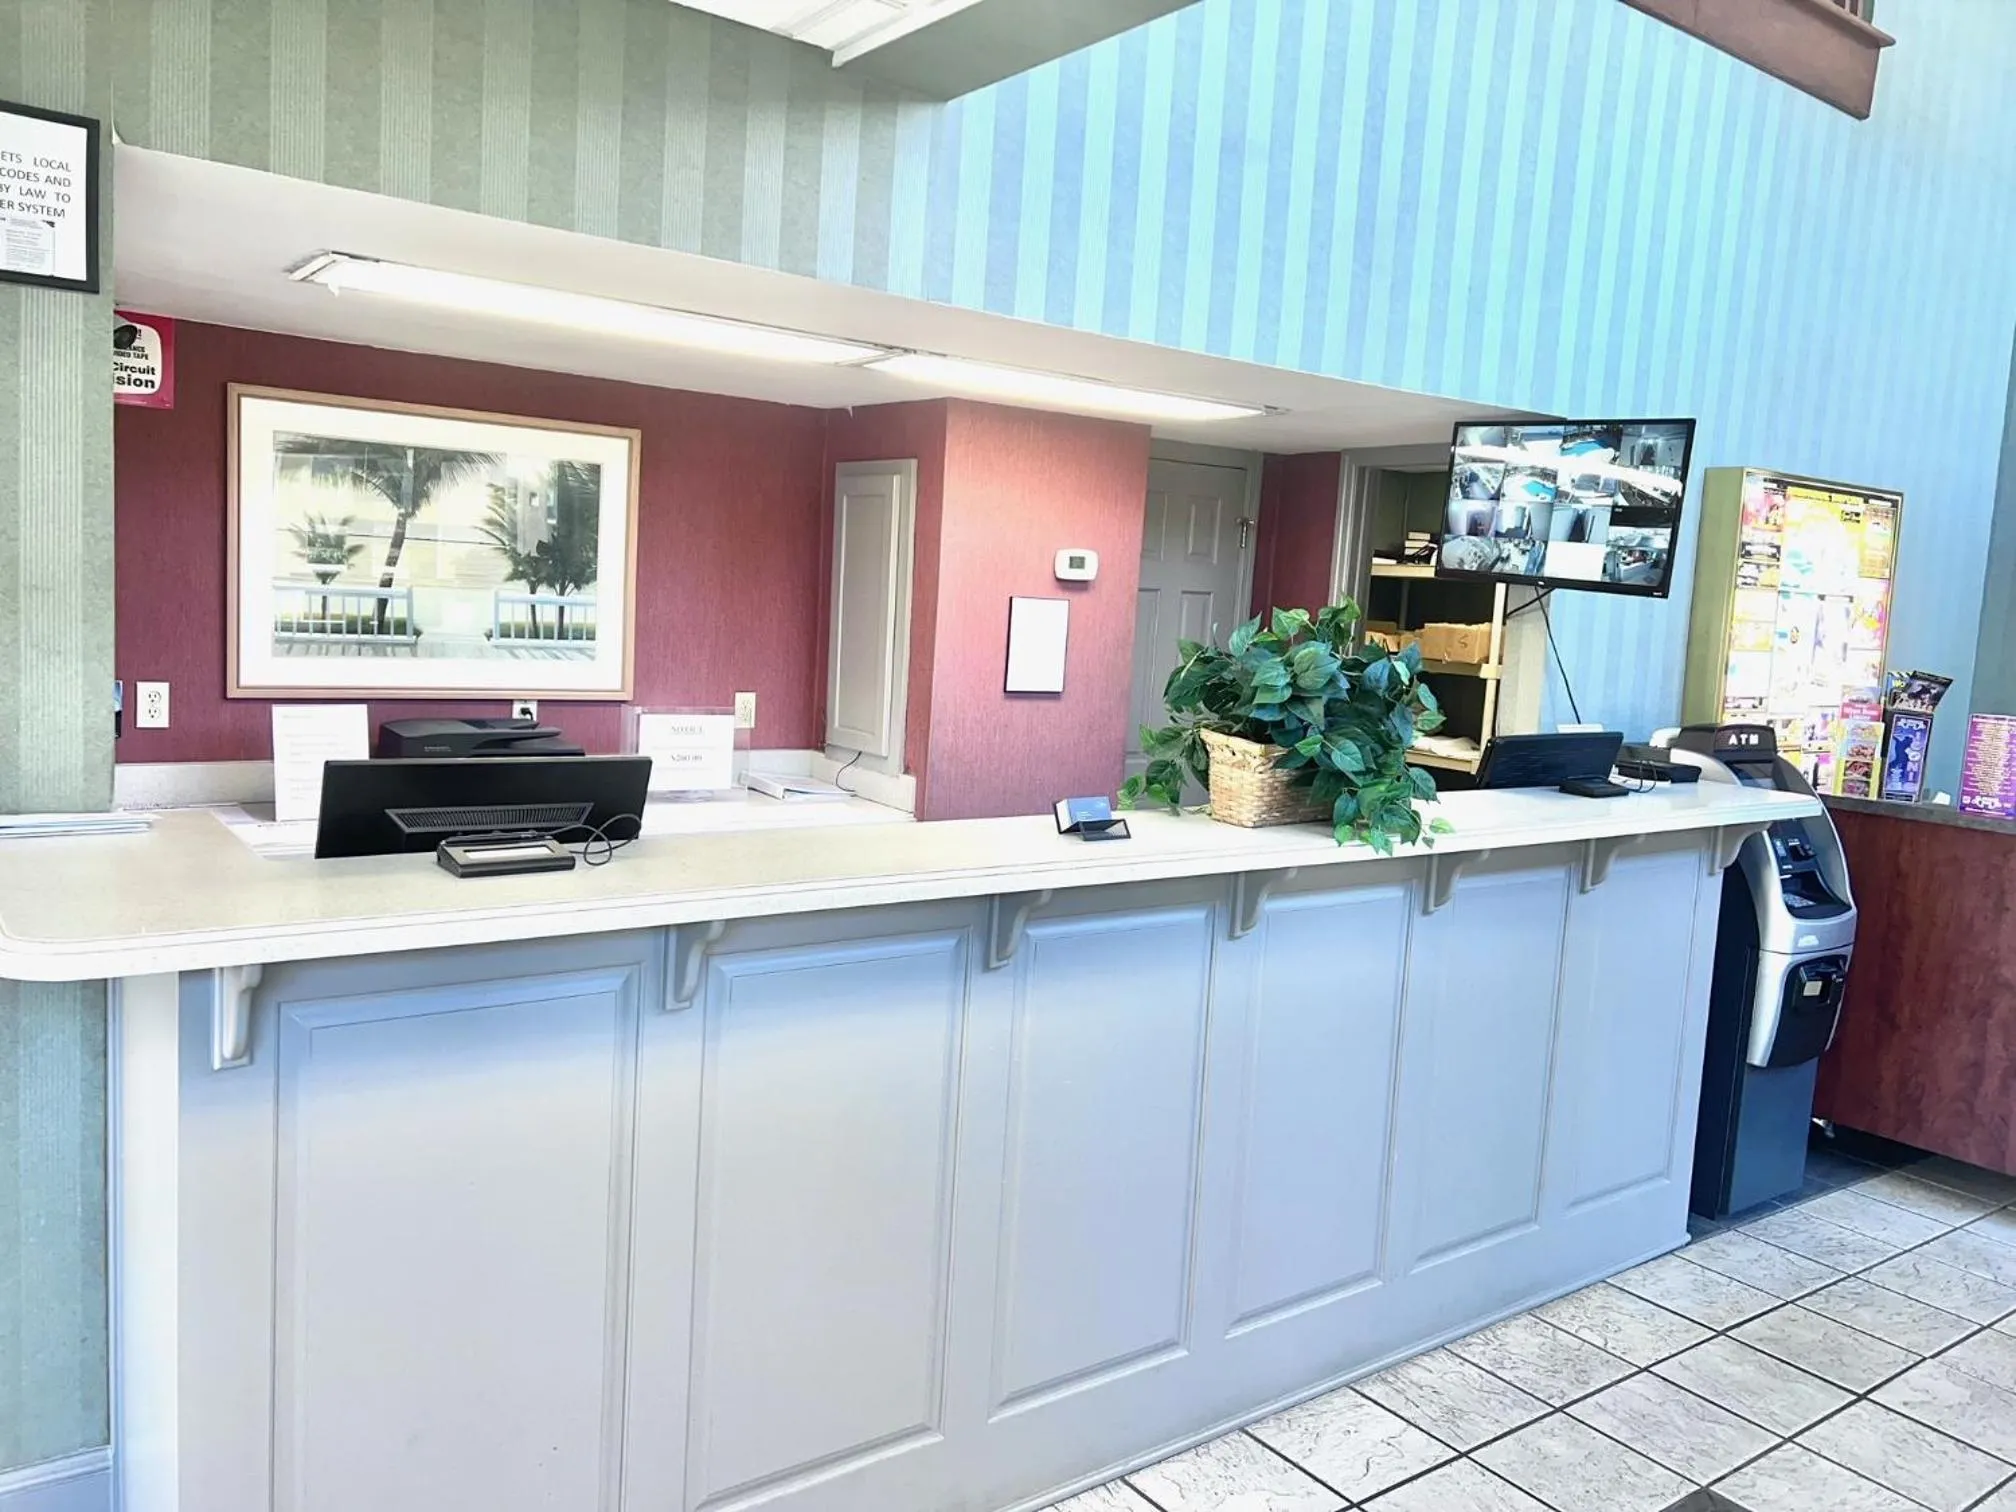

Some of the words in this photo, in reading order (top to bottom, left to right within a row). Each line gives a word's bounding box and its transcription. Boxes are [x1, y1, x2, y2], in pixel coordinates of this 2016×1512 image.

[33, 156, 71, 172] LOCAL
[0, 167, 40, 182] CODES
[45, 175, 71, 187] AND
[19, 186, 46, 199] LAW
[54, 191, 71, 203] TO
[18, 201, 66, 218] SYSTEM
[1728, 733, 1759, 746] ATM
